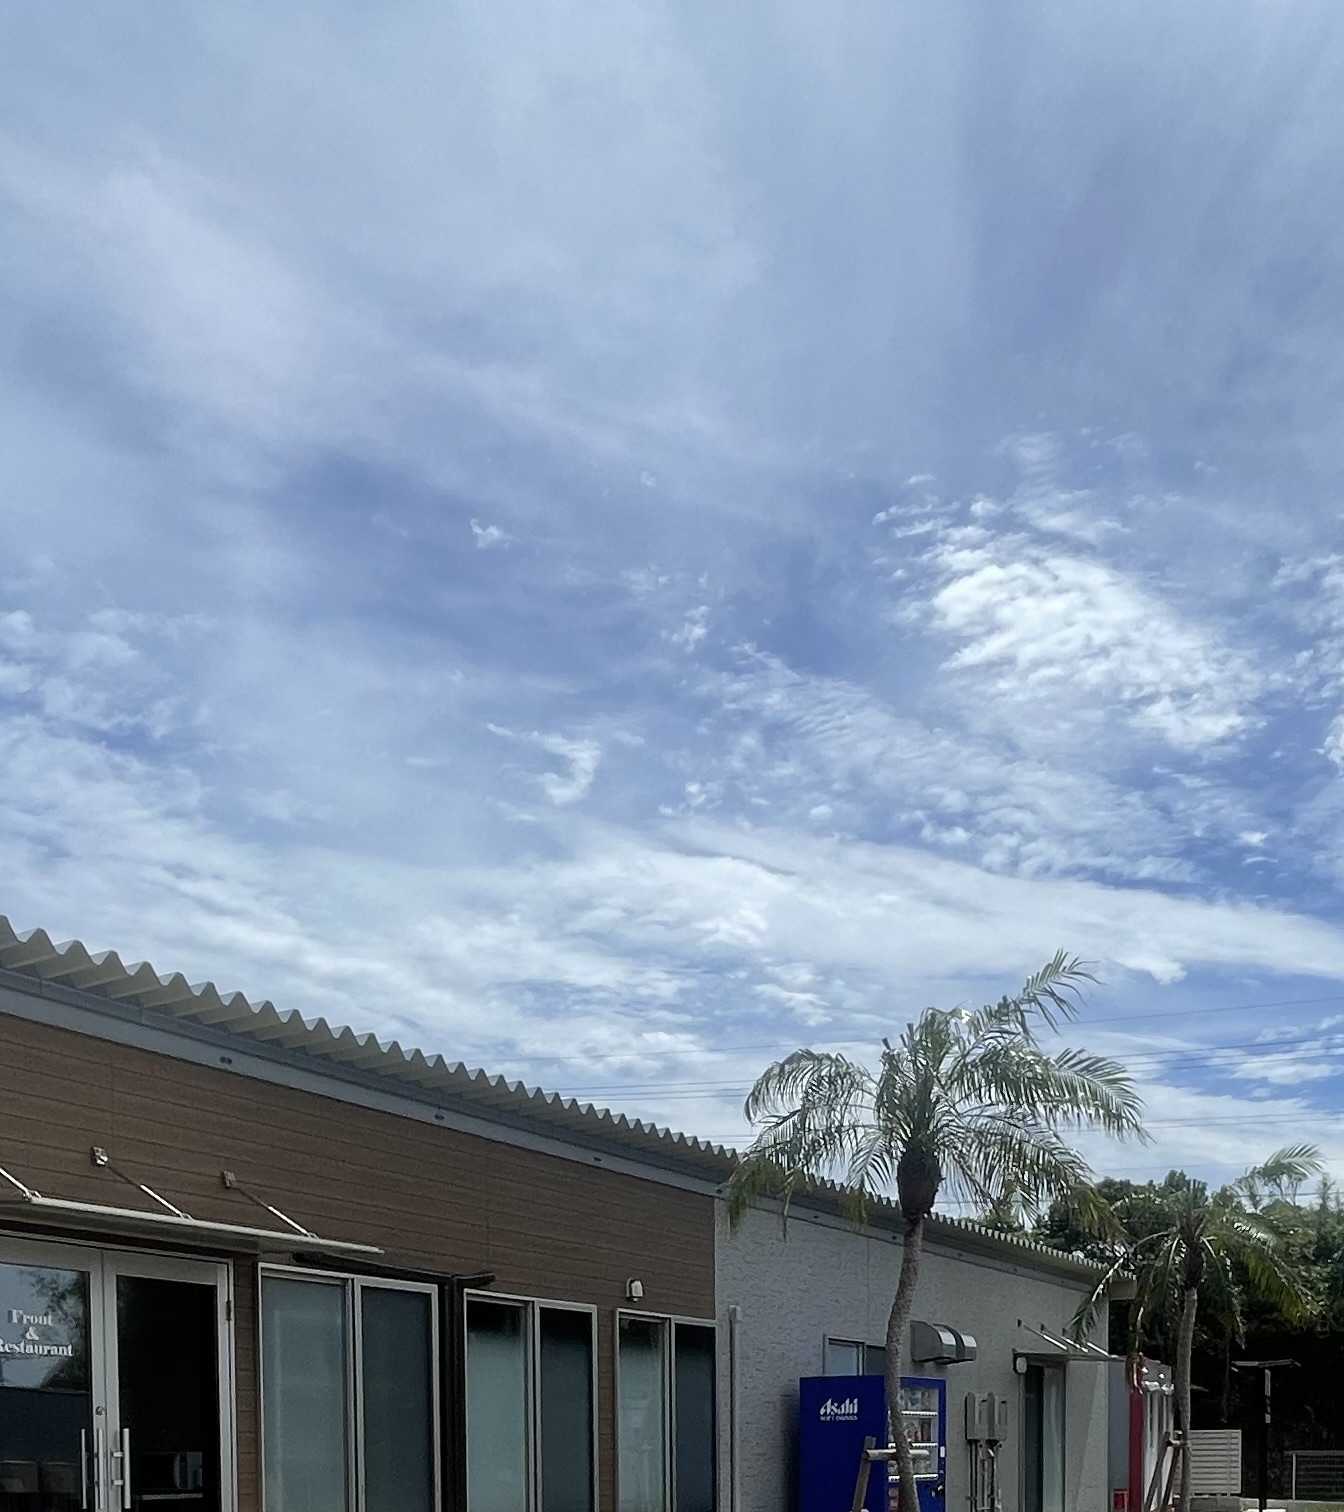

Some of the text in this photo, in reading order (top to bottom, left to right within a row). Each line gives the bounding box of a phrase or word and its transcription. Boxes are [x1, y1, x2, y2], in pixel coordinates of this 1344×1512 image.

[9, 1308, 53, 1326] Front
[24, 1326, 40, 1341] &
[819, 1397, 858, 1416] Asahi
